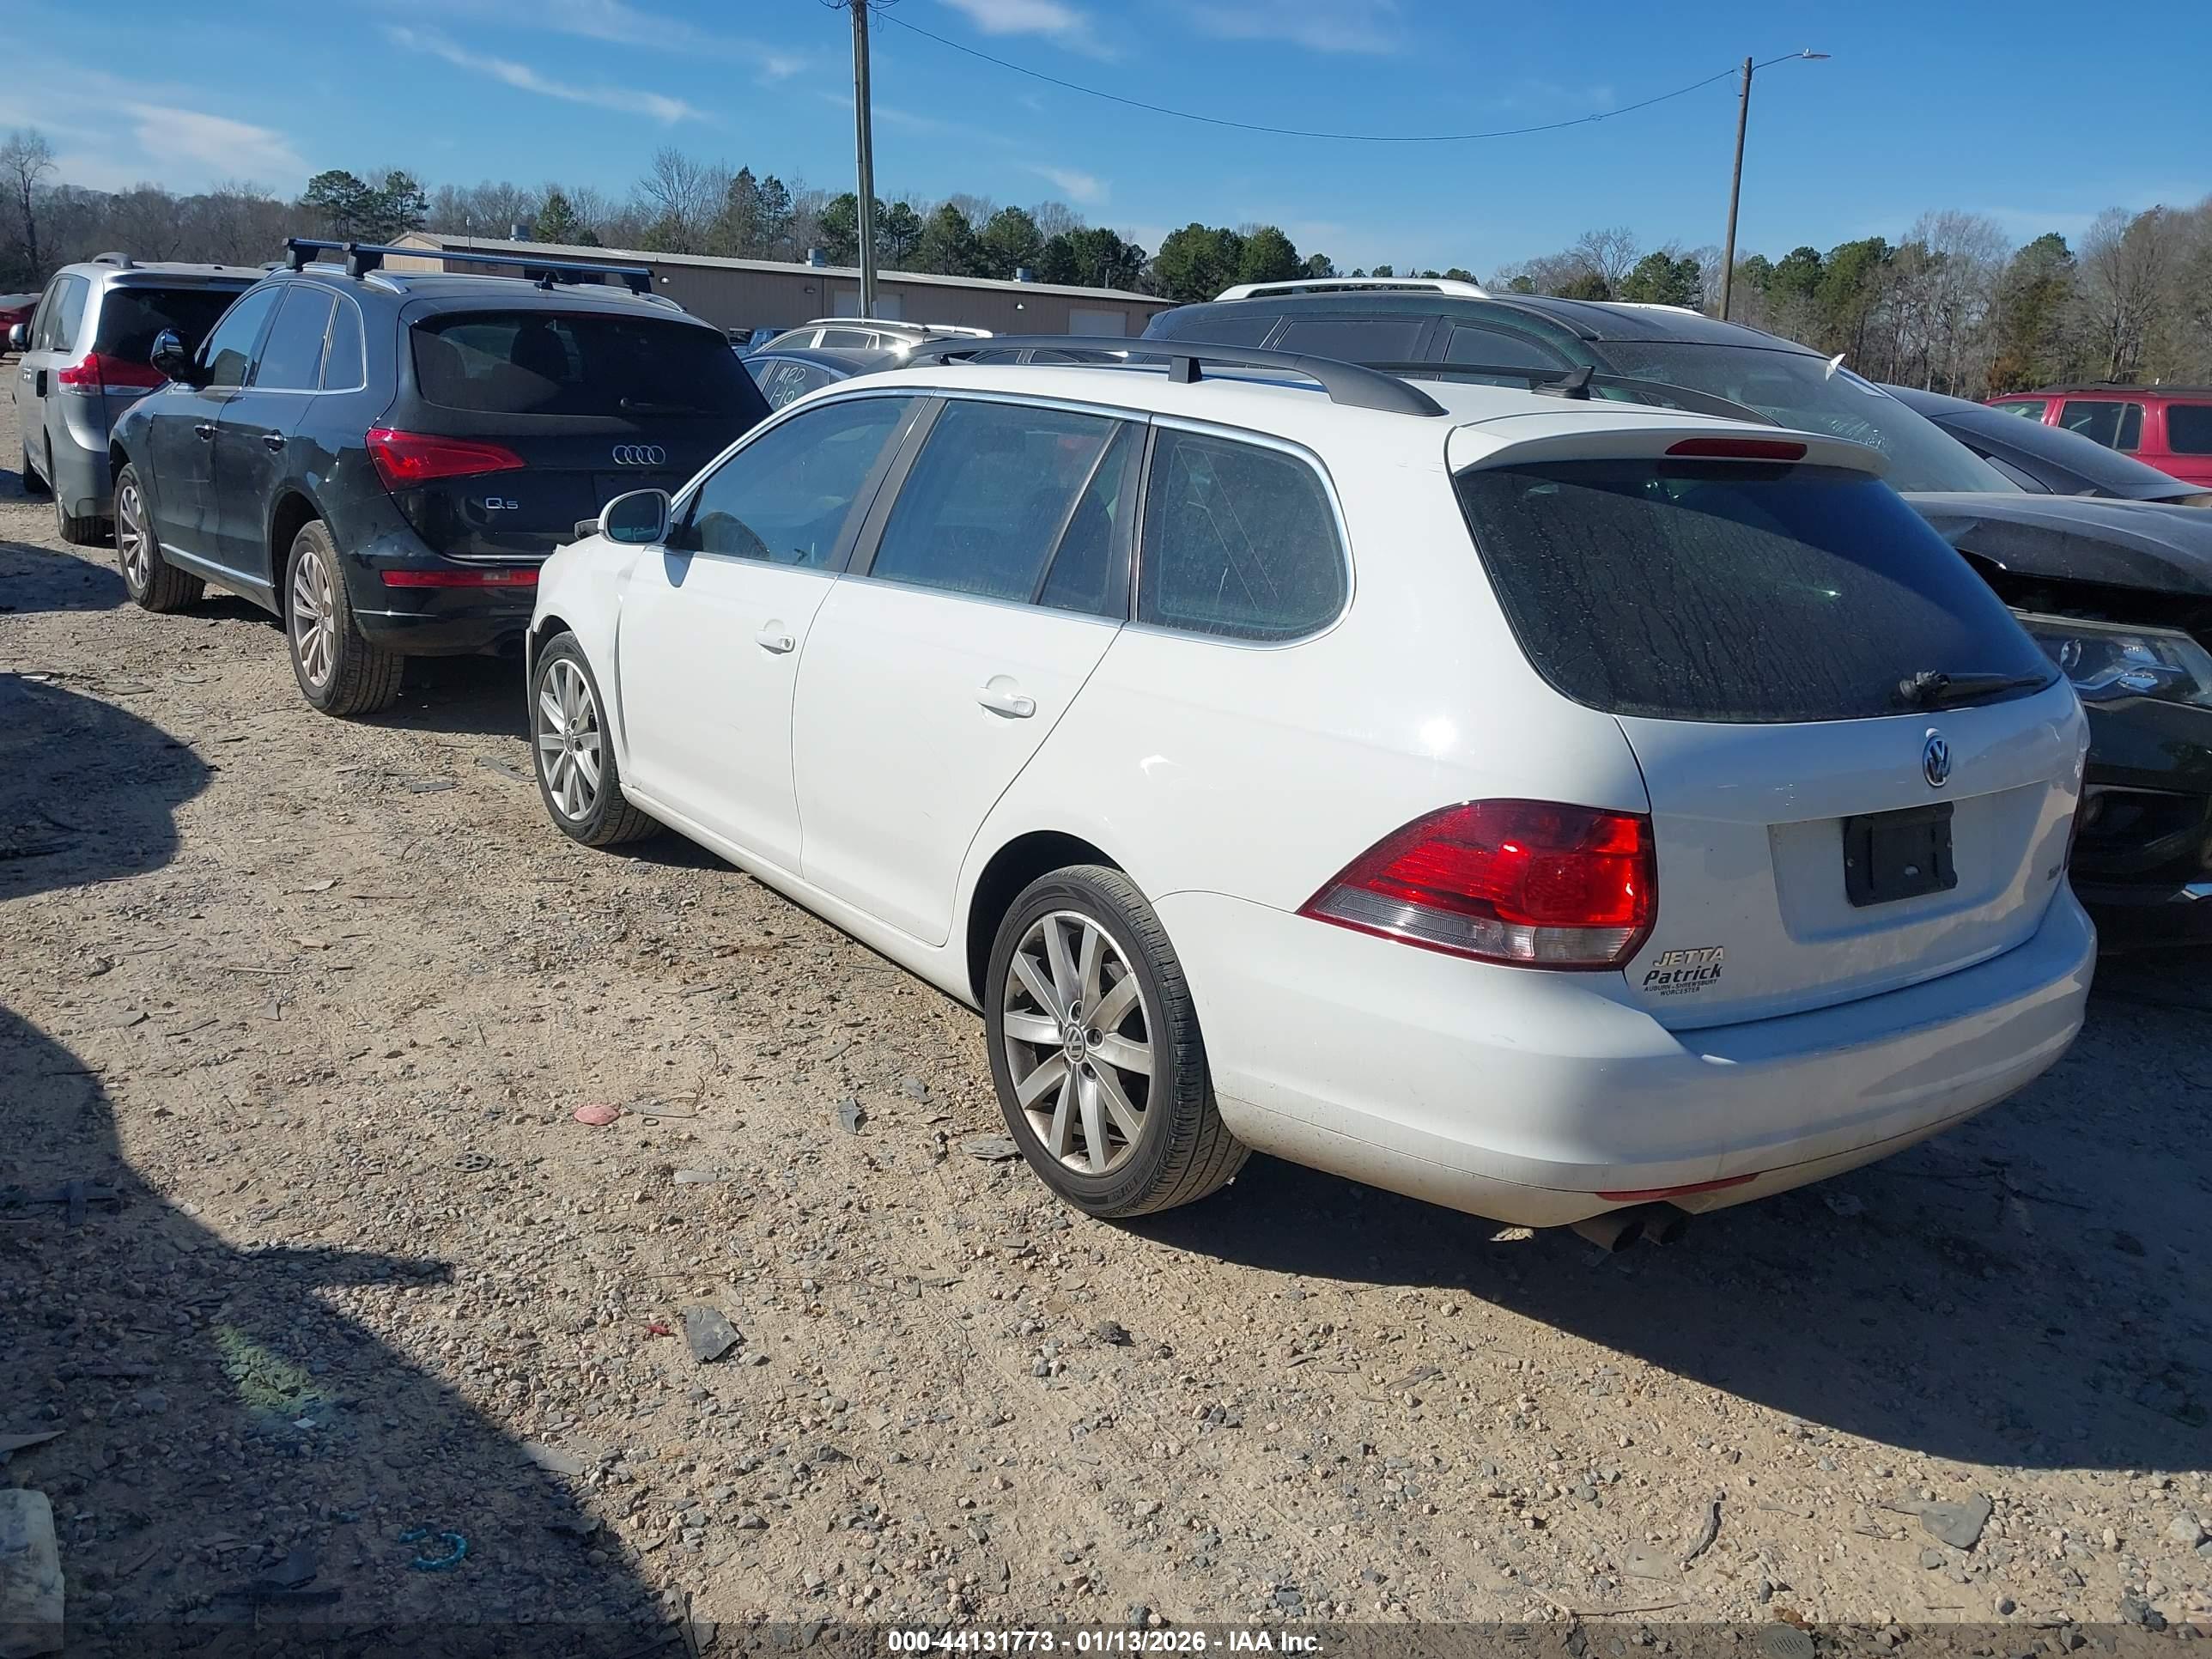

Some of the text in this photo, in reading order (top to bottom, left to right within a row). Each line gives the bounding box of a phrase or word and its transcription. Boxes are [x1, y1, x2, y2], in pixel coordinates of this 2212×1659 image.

[775, 367, 806, 385] MPD
[485, 498, 519, 509] Q5
[1653, 945, 1724, 967] JETTA
[1643, 963, 1723, 986] Patrick
